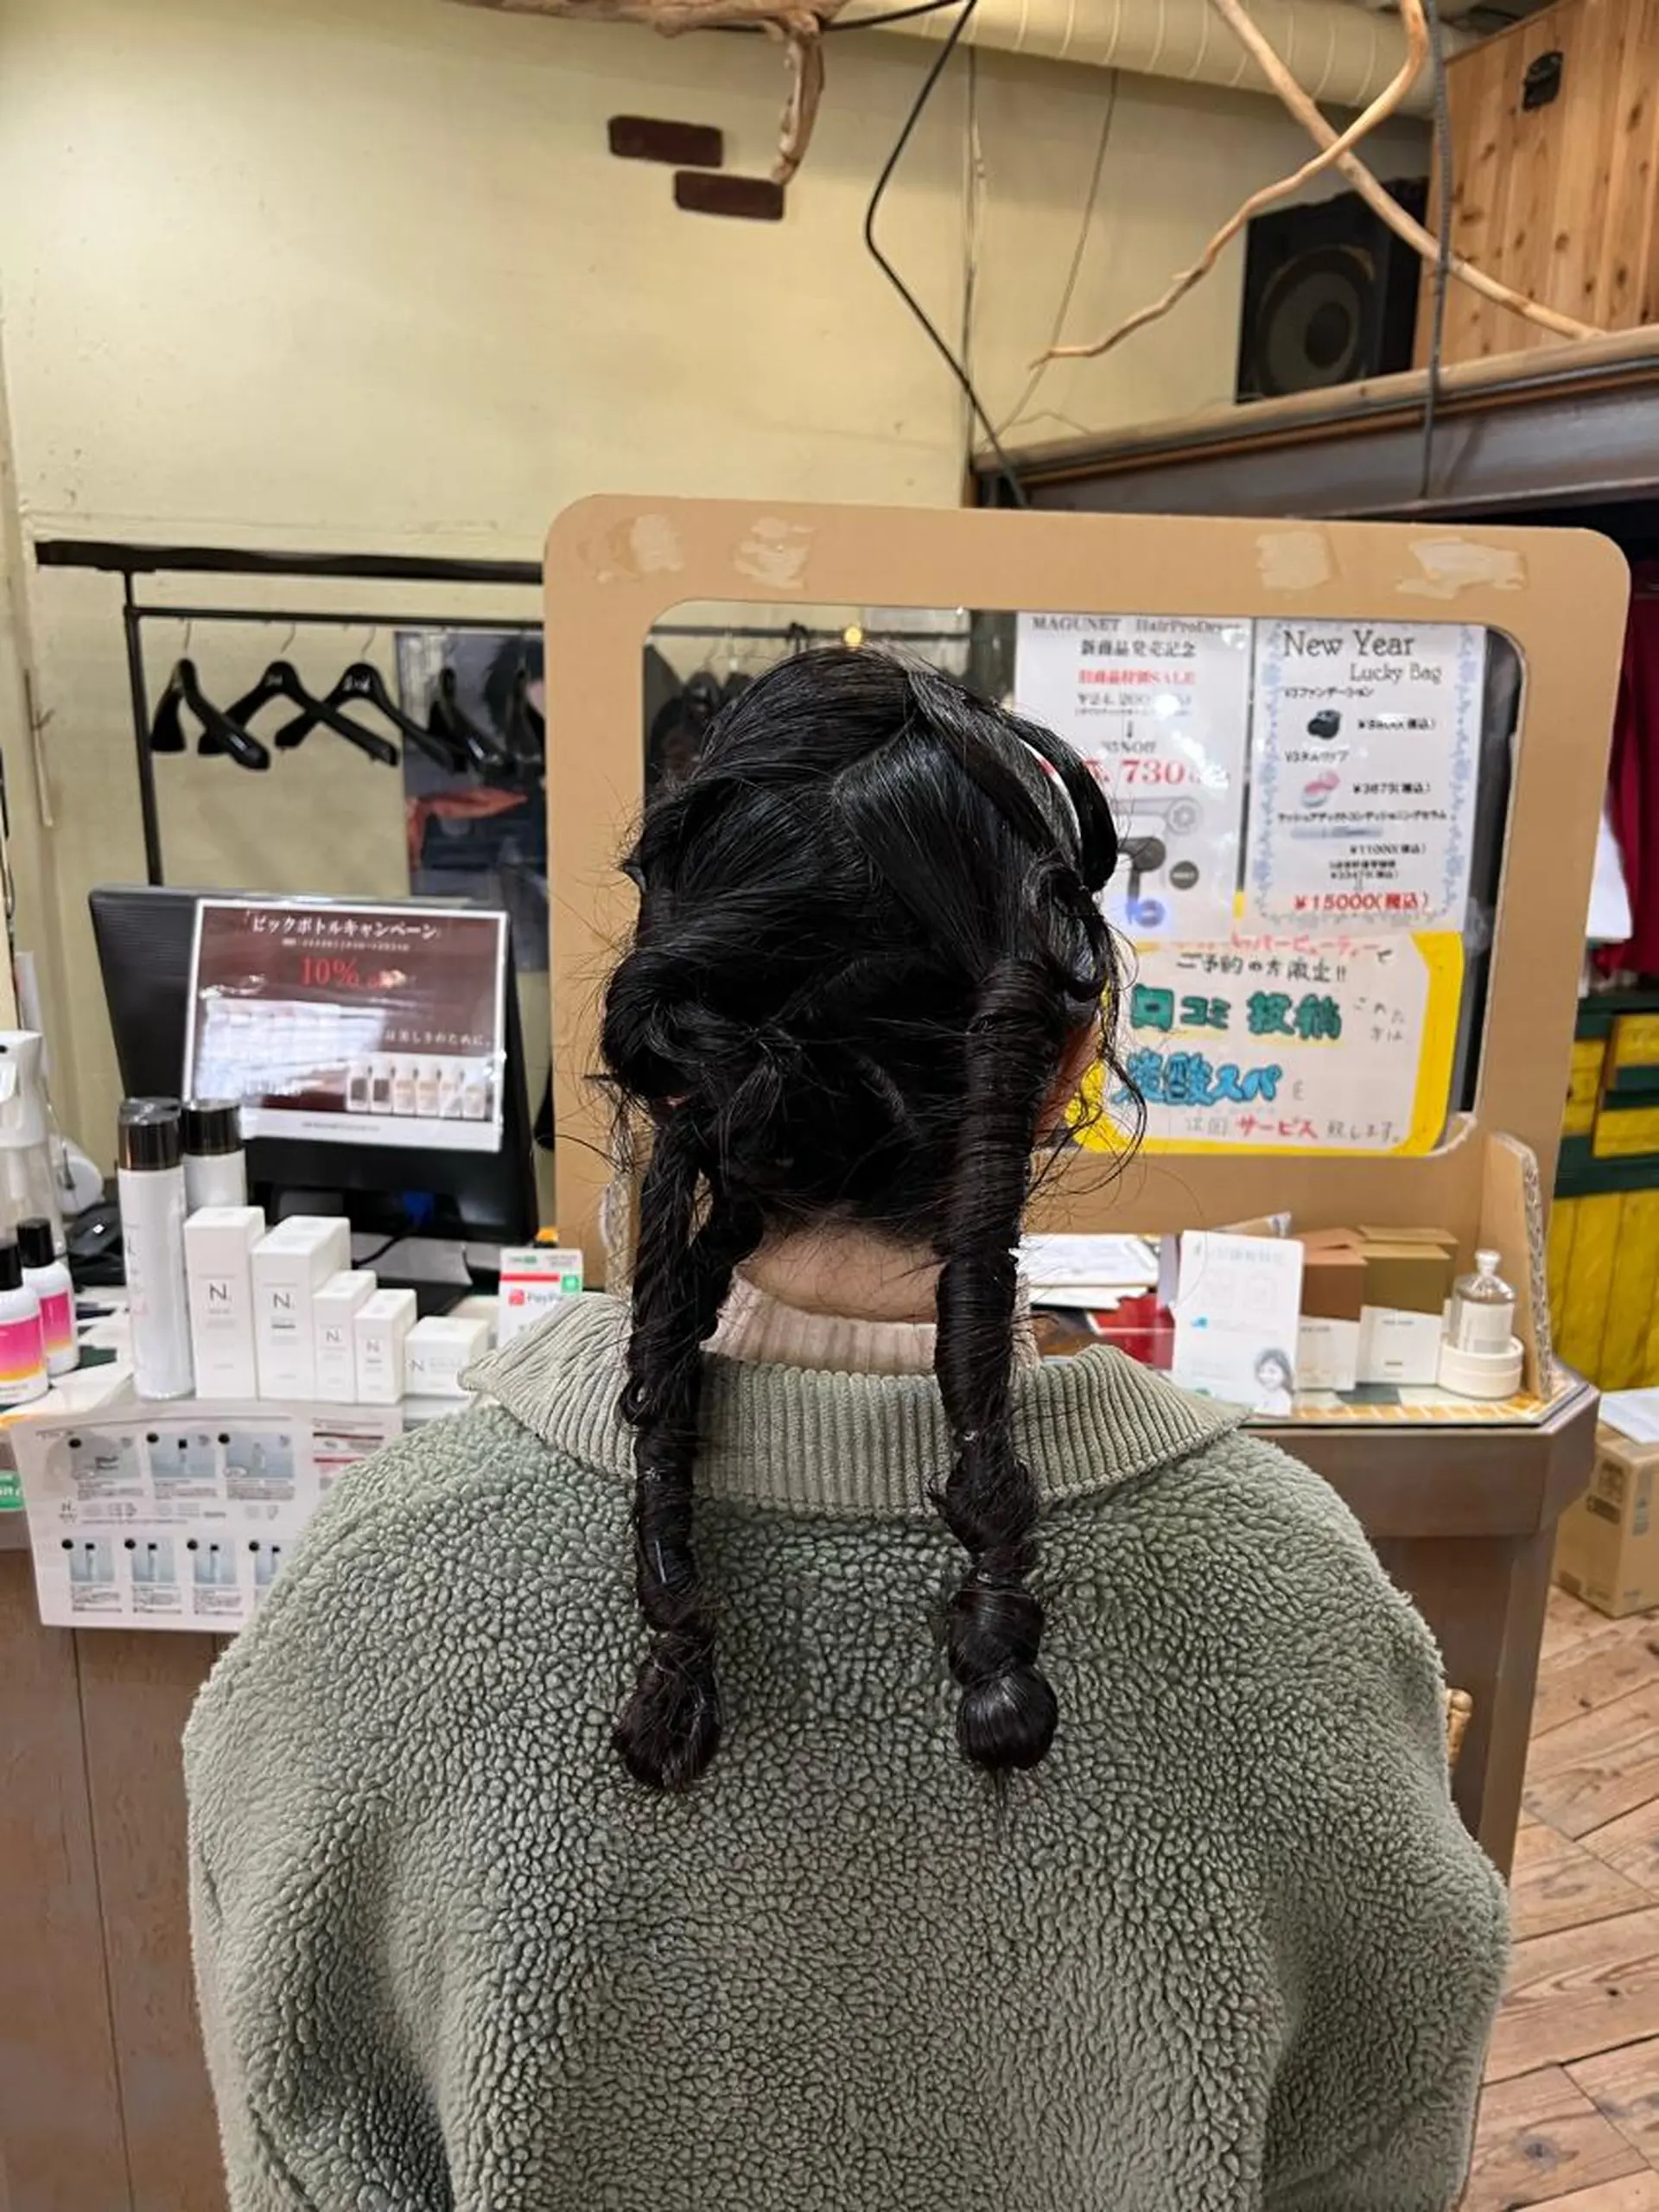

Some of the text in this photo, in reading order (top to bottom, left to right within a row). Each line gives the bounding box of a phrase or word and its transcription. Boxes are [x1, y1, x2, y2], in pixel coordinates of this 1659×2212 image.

[1033, 617, 1121, 632] MAGUNET
[1284, 629, 1416, 657] New Year
[1350, 662, 1443, 686] Lucky Bag
